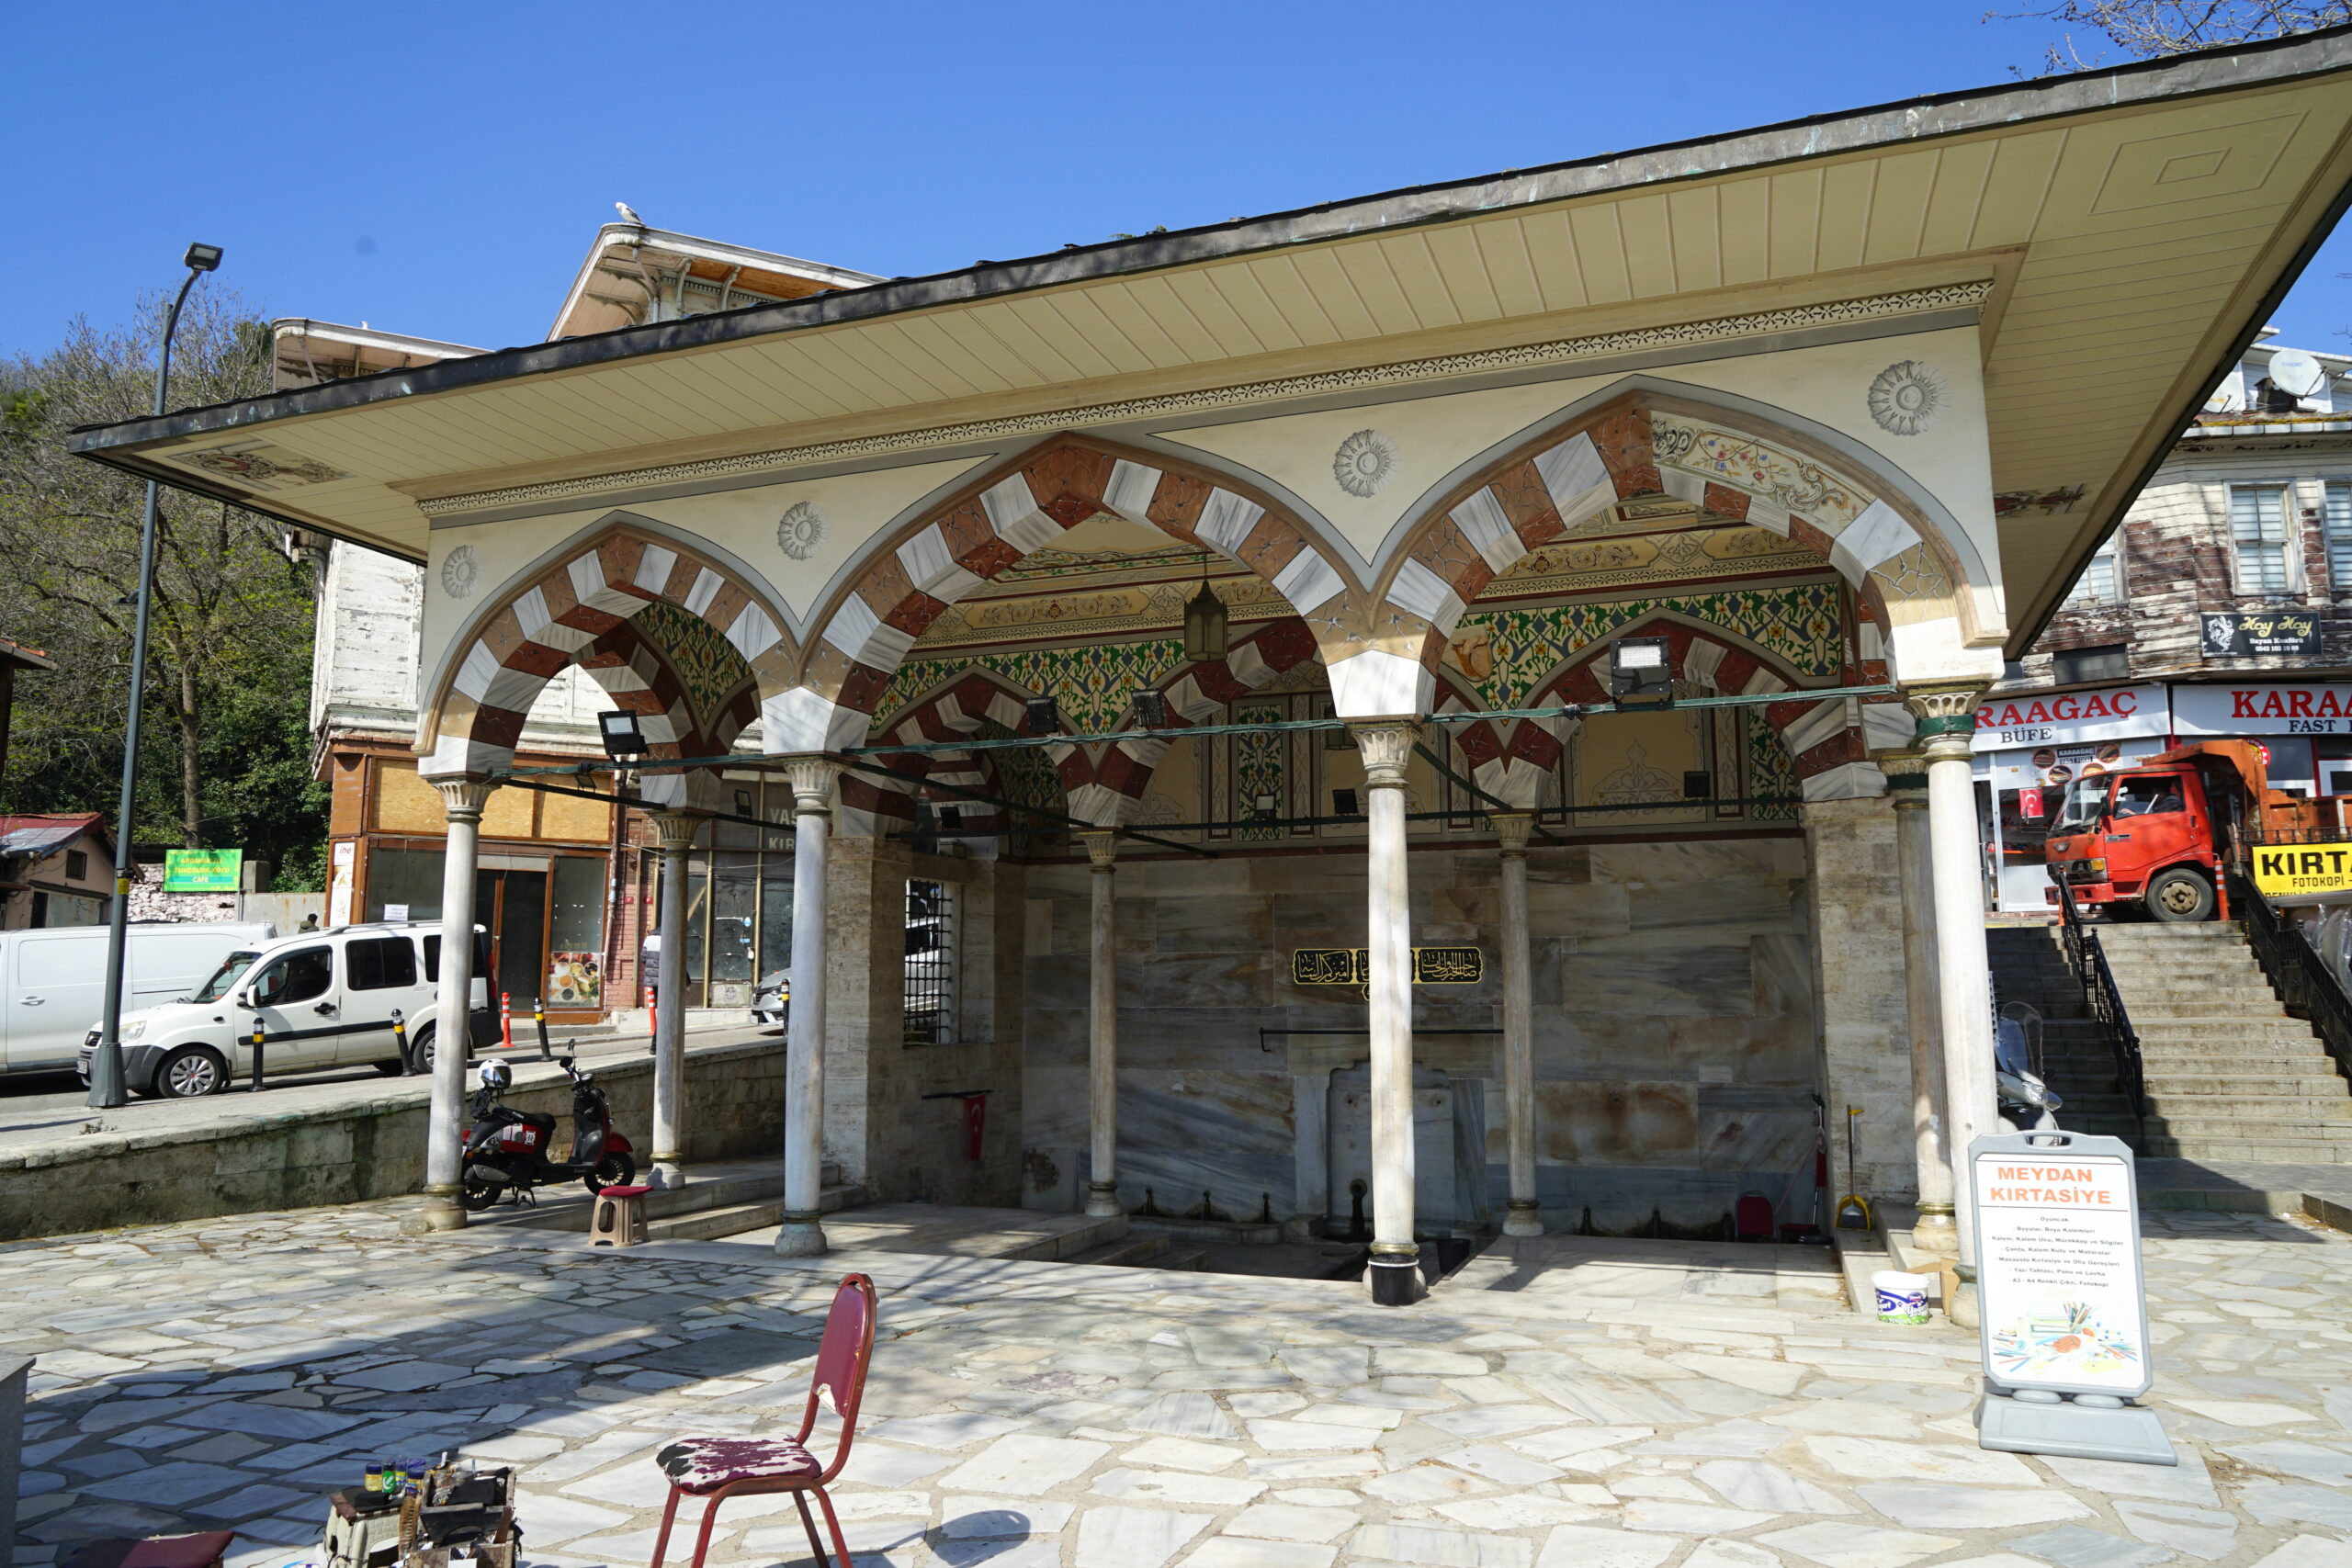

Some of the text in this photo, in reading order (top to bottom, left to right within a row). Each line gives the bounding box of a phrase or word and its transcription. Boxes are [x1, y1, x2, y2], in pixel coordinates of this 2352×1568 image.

[2289, 720, 2336, 732] FAST
[2000, 728, 2052, 743] BÜFE
[2261, 851, 2352, 875] KIRT
[2292, 874, 2345, 886] FOTOKOPİ
[1997, 1167, 2093, 1182] MEYDAN
[1990, 1187, 2111, 1204] KIRTASİYE
